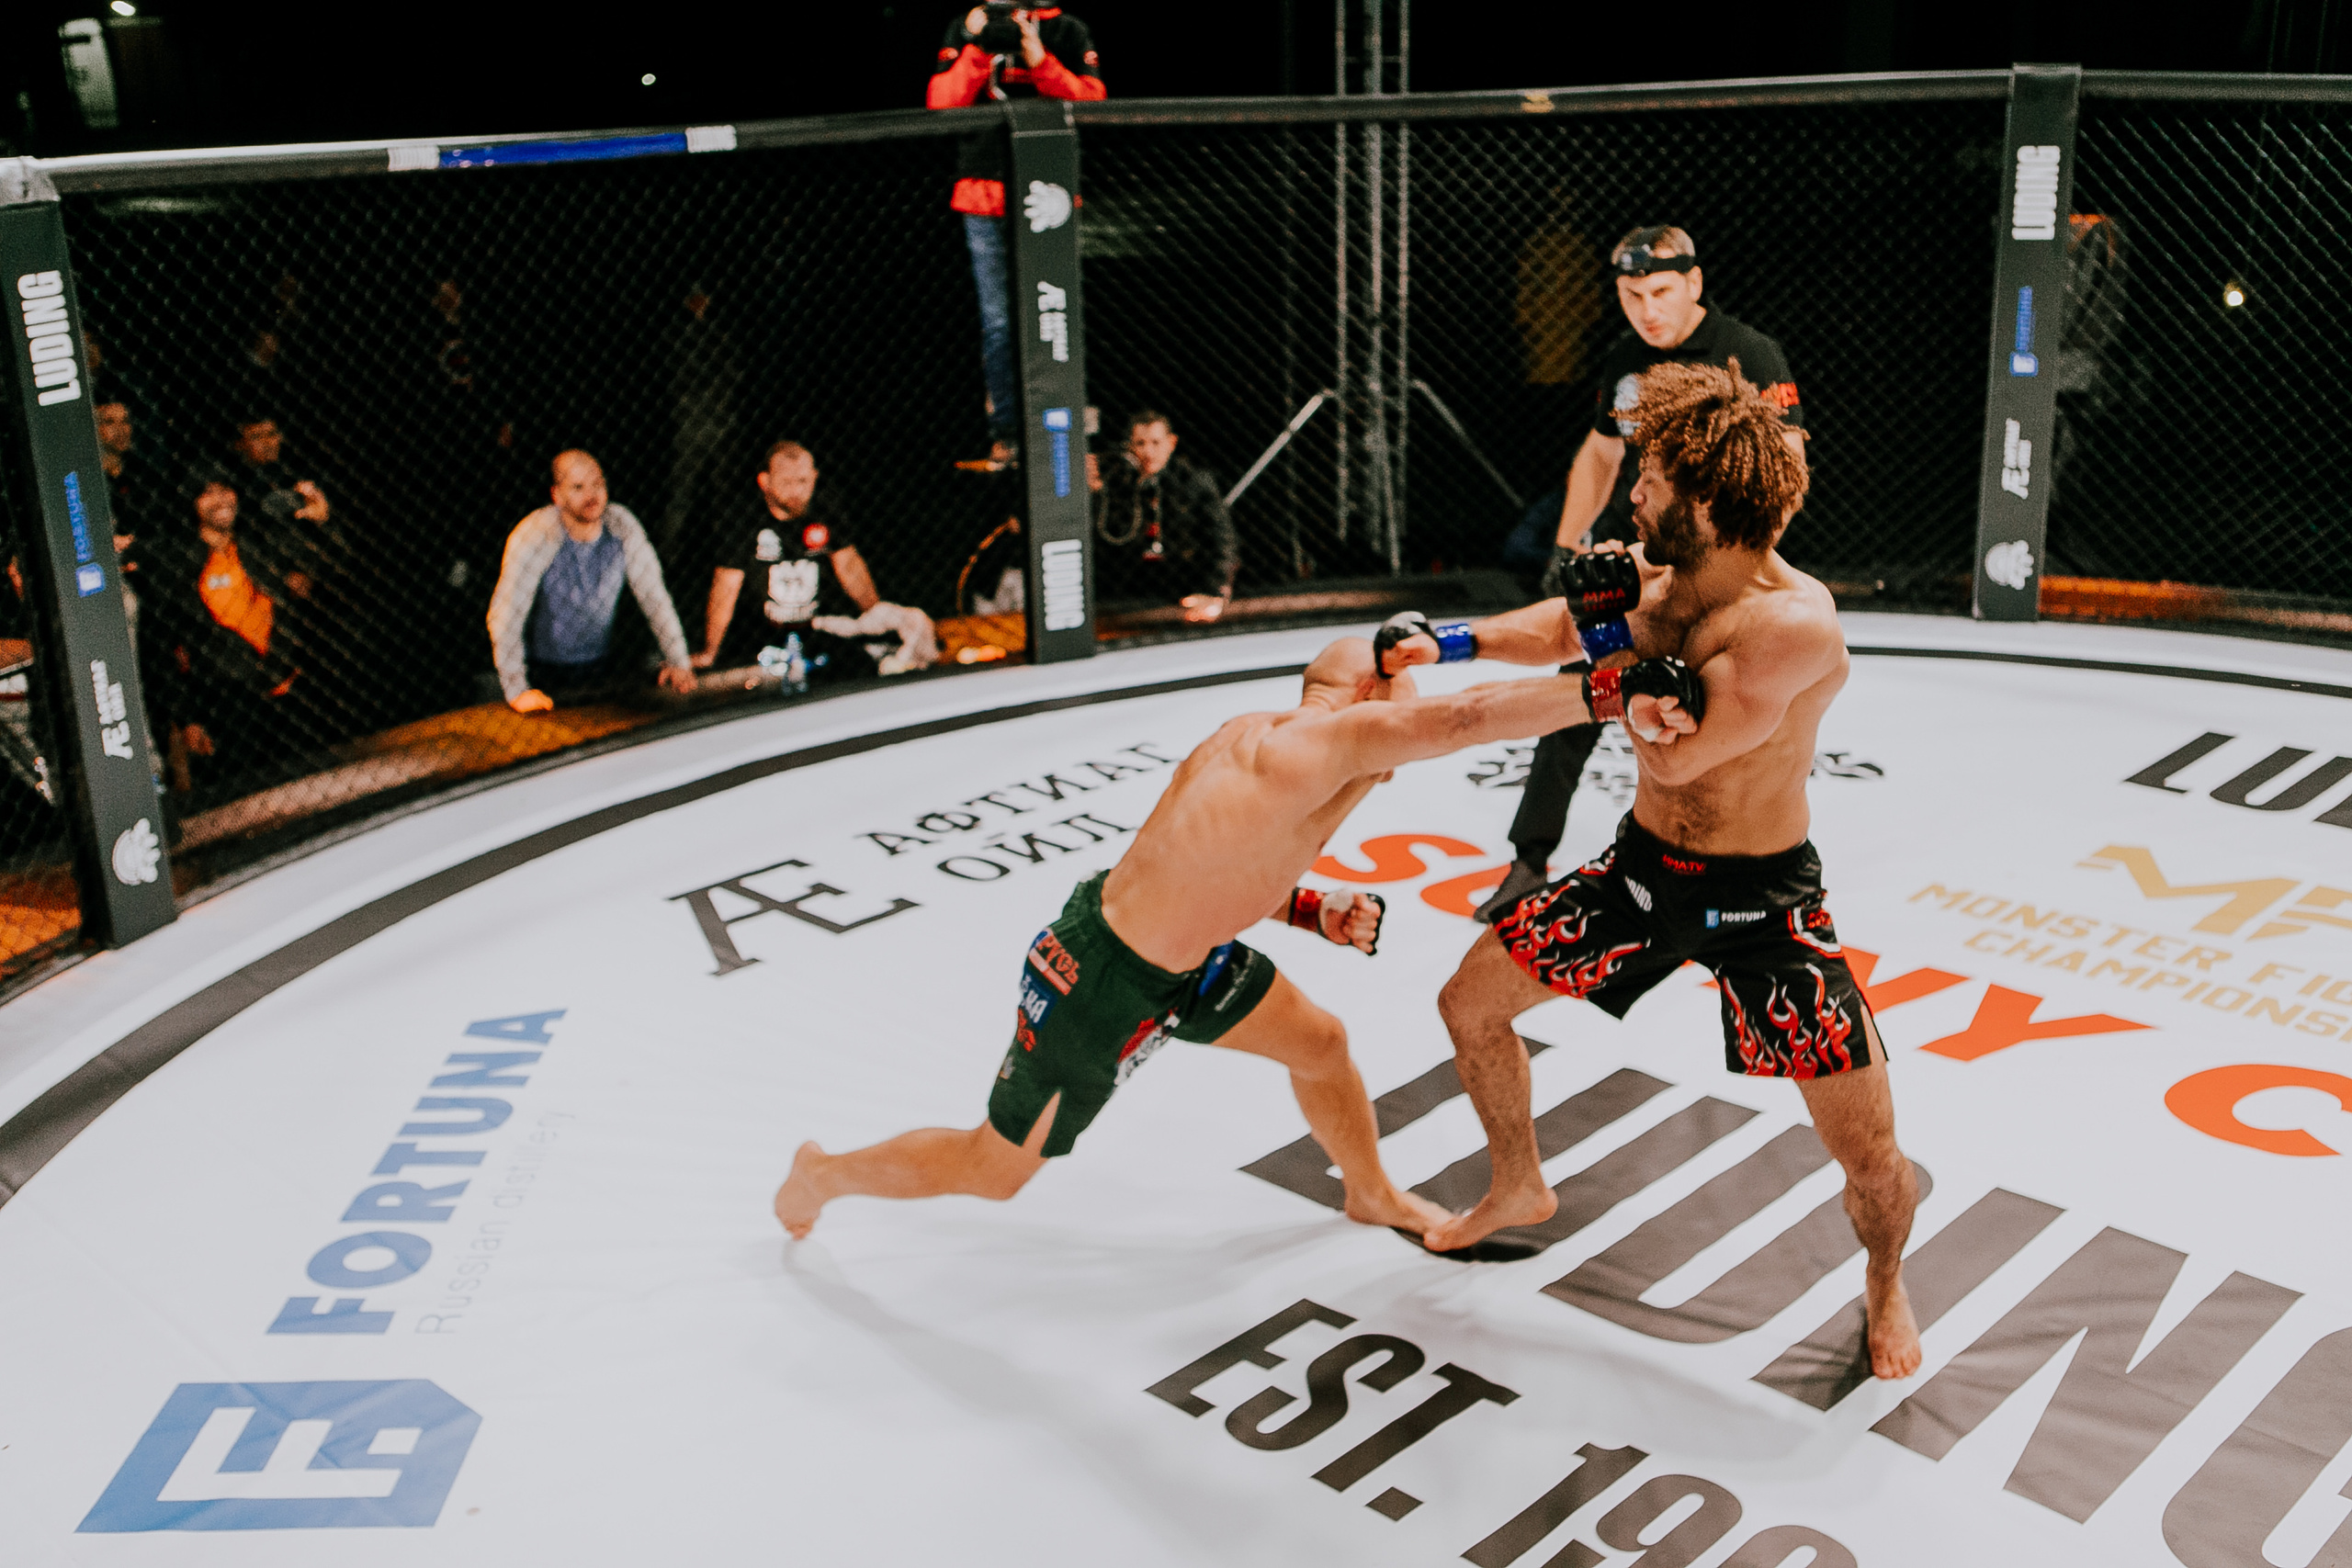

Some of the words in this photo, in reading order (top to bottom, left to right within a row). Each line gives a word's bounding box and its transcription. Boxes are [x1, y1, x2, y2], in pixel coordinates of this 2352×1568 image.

[17, 270, 81, 407] LUDING
[1582, 588, 1625, 604] MMA
[2122, 731, 2352, 829] LU
[1721, 910, 1767, 922] FORTUNA
[1907, 883, 2233, 972] MONSTER
[1962, 929, 2352, 1045] CHAMPIONS
[265, 1008, 568, 1335] FORTUNA
[414, 1221, 511, 1334] Russian
[1142, 1298, 1521, 1522] EST.
